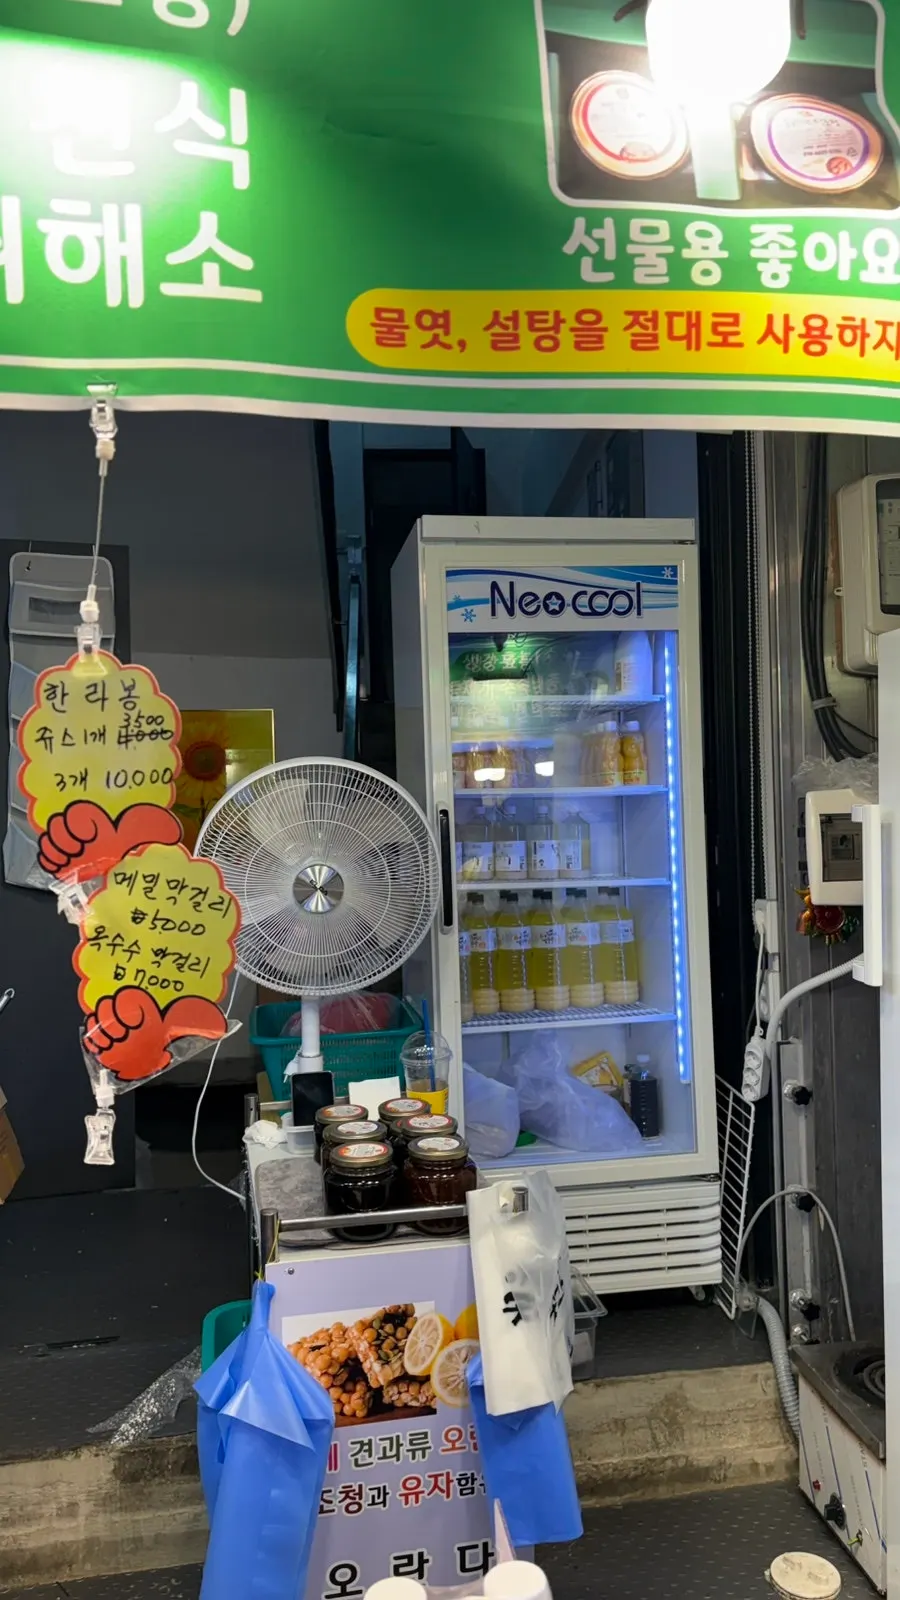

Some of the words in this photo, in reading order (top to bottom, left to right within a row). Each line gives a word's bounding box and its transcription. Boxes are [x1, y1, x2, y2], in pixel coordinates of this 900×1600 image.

[562, 216, 729, 286] 선물용
[749, 222, 900, 289] 좋아요
[370, 306, 467, 353] 물엿,
[482, 308, 609, 353] 설탕을
[622, 308, 745, 352] 절대로
[54, 767, 88, 792] 3개
[87, 925, 141, 963] 옥수수
[151, 946, 211, 979] 막걸리
[350, 1431, 432, 1468] 견과류
